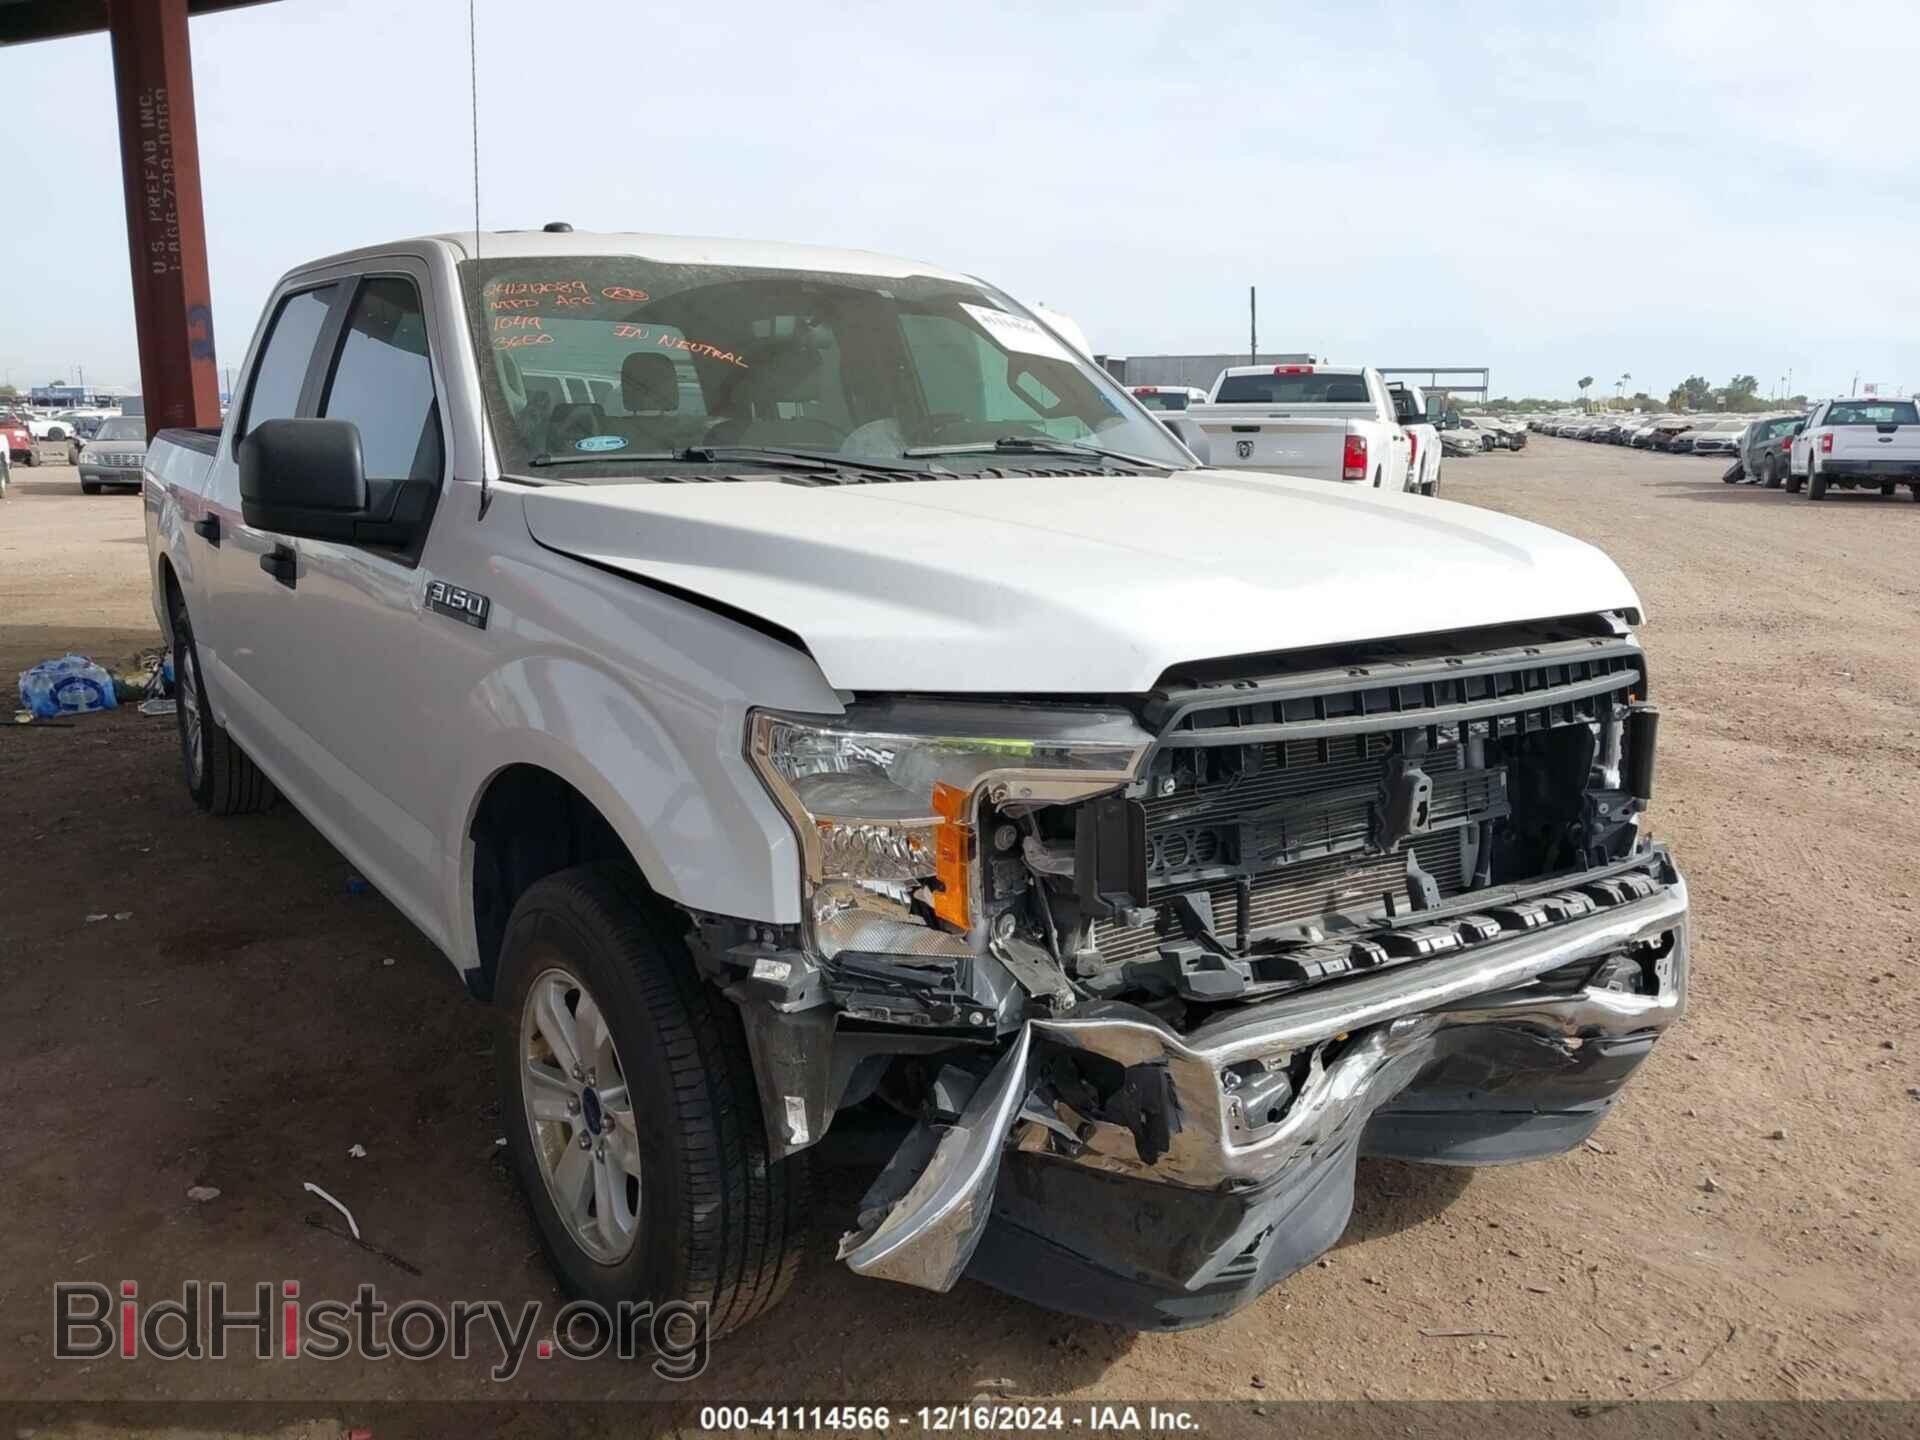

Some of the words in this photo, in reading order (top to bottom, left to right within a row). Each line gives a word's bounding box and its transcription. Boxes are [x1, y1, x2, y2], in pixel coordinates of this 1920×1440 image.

[139, 87, 156, 128] INC.
[143, 140, 162, 222] PREFAB
[151, 234, 168, 274] U.S.
[613, 325, 648, 339] IN
[658, 334, 749, 369] NEUTRAL
